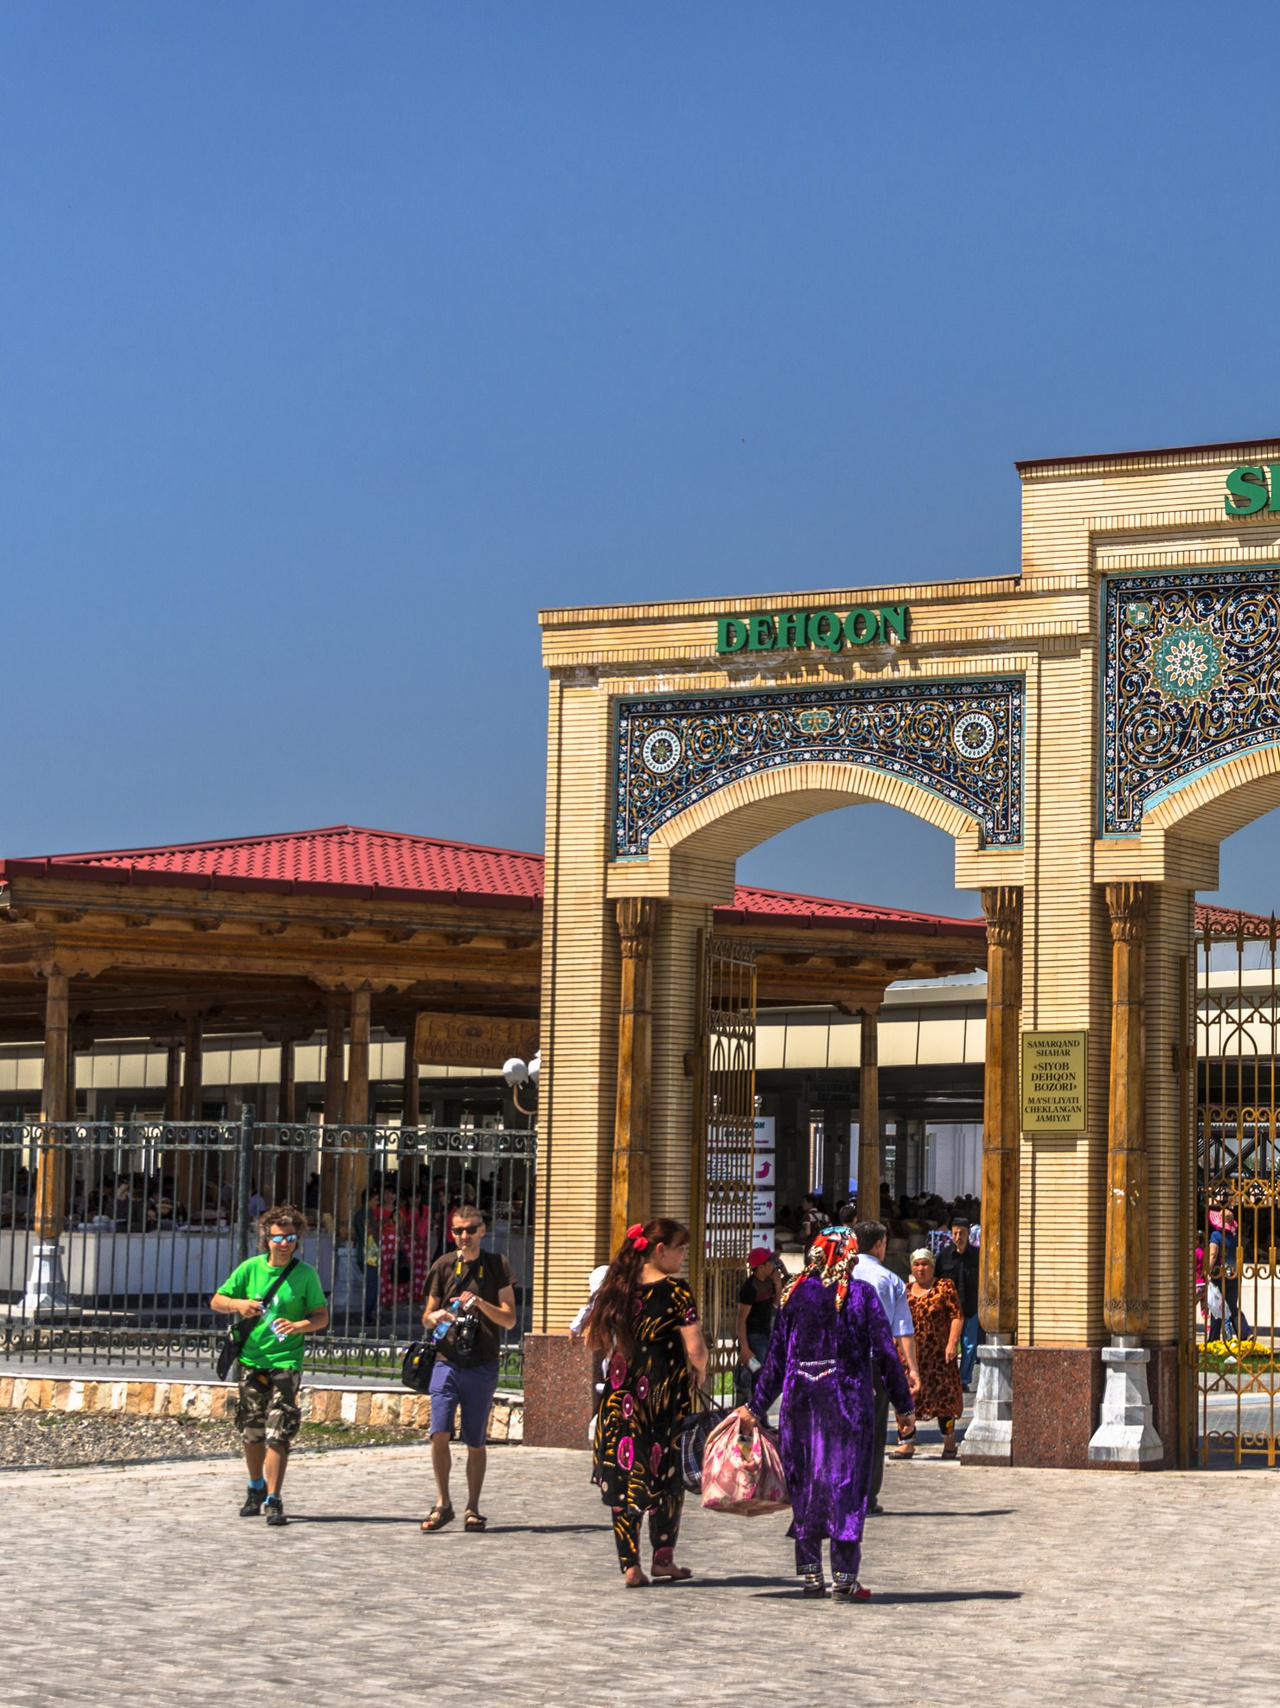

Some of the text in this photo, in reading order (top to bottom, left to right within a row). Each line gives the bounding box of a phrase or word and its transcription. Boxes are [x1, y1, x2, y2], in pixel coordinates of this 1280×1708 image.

[716, 605, 907, 653] DEHQON
[1027, 1040, 1081, 1048] SAMARQAND
[1036, 1049, 1071, 1057] SHAHAR
[1033, 1061, 1070, 1071] «SIYOB
[1031, 1072, 1076, 1082] DEHQON
[1034, 1082, 1078, 1092] BOZORI»
[1024, 1105, 1082, 1114] CHEKLANGAN
[1035, 1114, 1071, 1122] JAMIYAT
